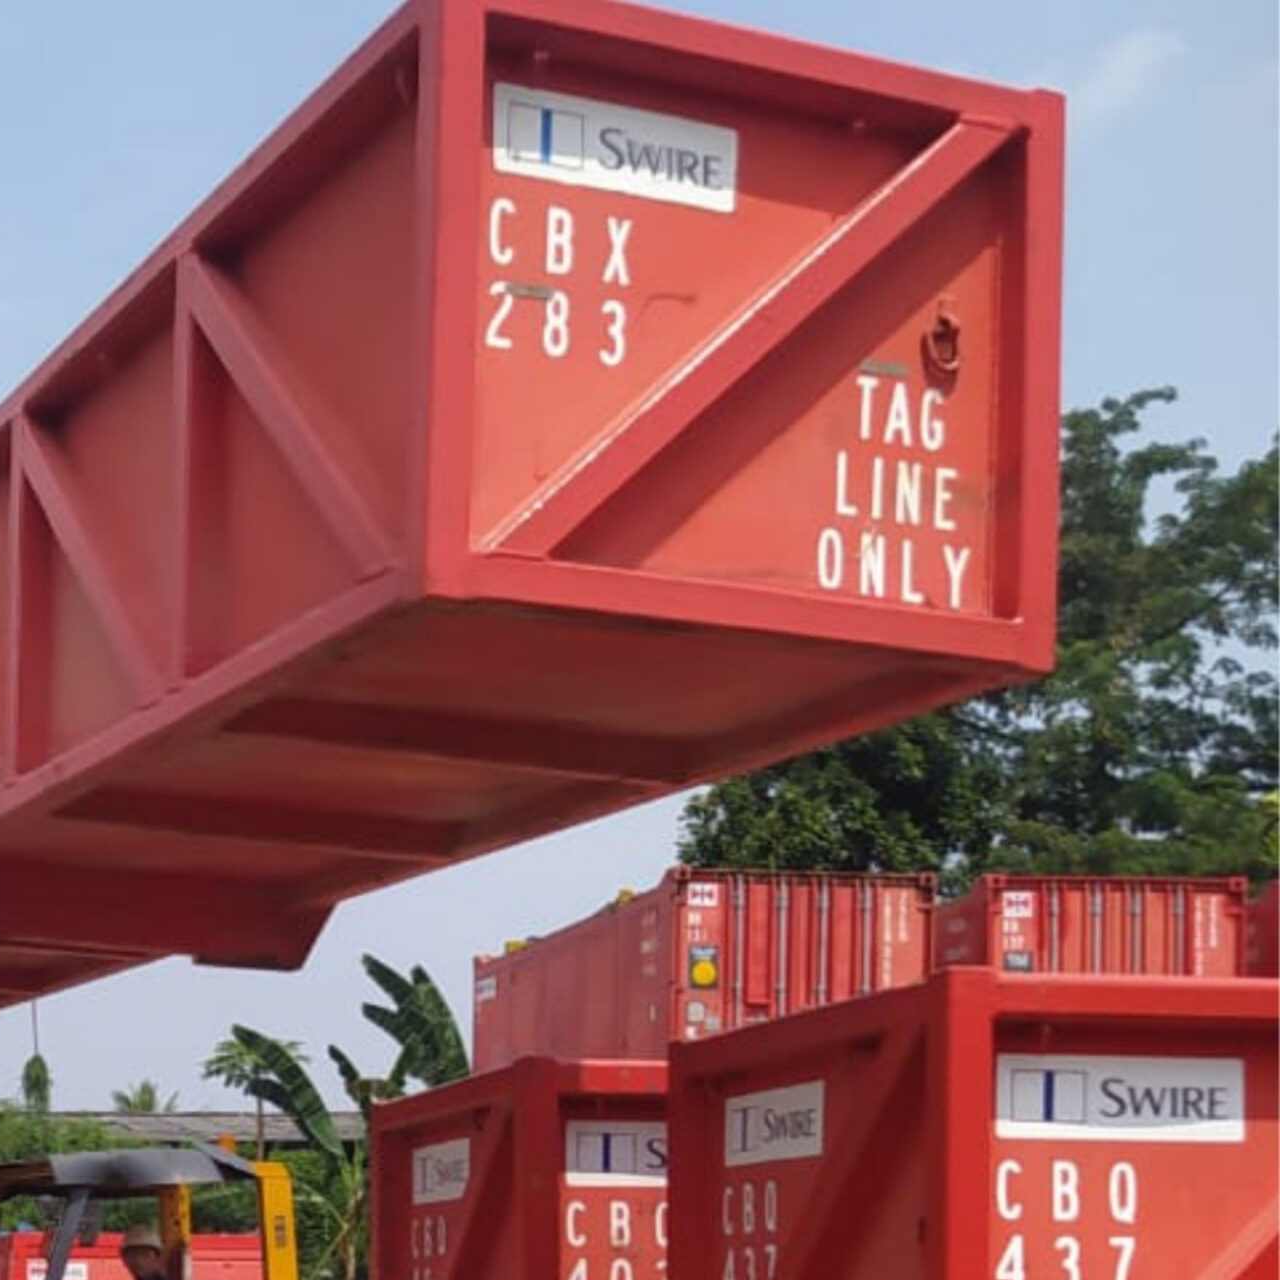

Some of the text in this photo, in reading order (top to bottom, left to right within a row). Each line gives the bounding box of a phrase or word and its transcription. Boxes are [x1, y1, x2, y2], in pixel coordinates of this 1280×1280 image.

[597, 126, 723, 191] SWIRE
[488, 198, 633, 287] CBX
[485, 282, 627, 366] 283
[856, 375, 946, 452] TAG
[835, 451, 958, 531] LINE
[817, 529, 971, 609] ONLY
[763, 1107, 817, 1142] SWIRE
[1099, 1077, 1229, 1122] SWIRE
[723, 1180, 778, 1236] CBQ
[995, 1159, 1138, 1224] CBQ
